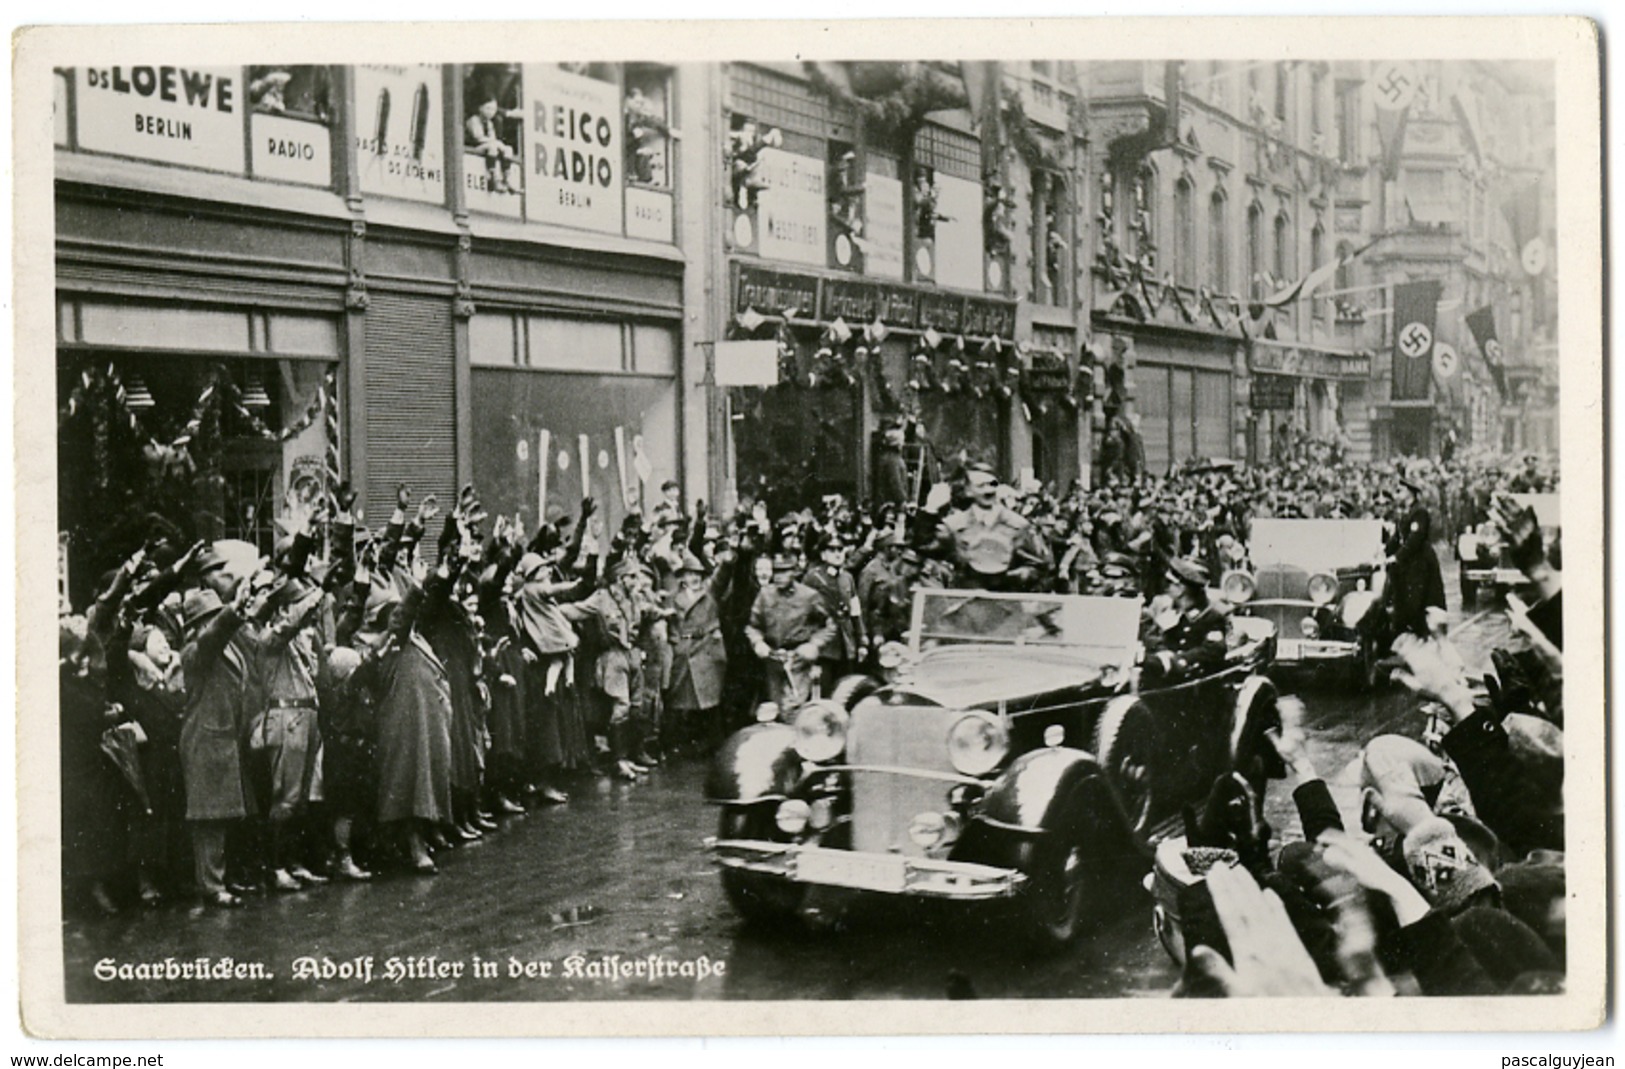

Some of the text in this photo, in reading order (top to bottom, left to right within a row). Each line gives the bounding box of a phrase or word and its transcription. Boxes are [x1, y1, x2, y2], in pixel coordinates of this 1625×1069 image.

[134, 113, 193, 141] BERLIN
[533, 100, 612, 148] REICO
[267, 137, 315, 161] RADIO
[534, 142, 613, 189] RADIO
[558, 187, 592, 209] BERLIN
[634, 204, 664, 224] RADIO
